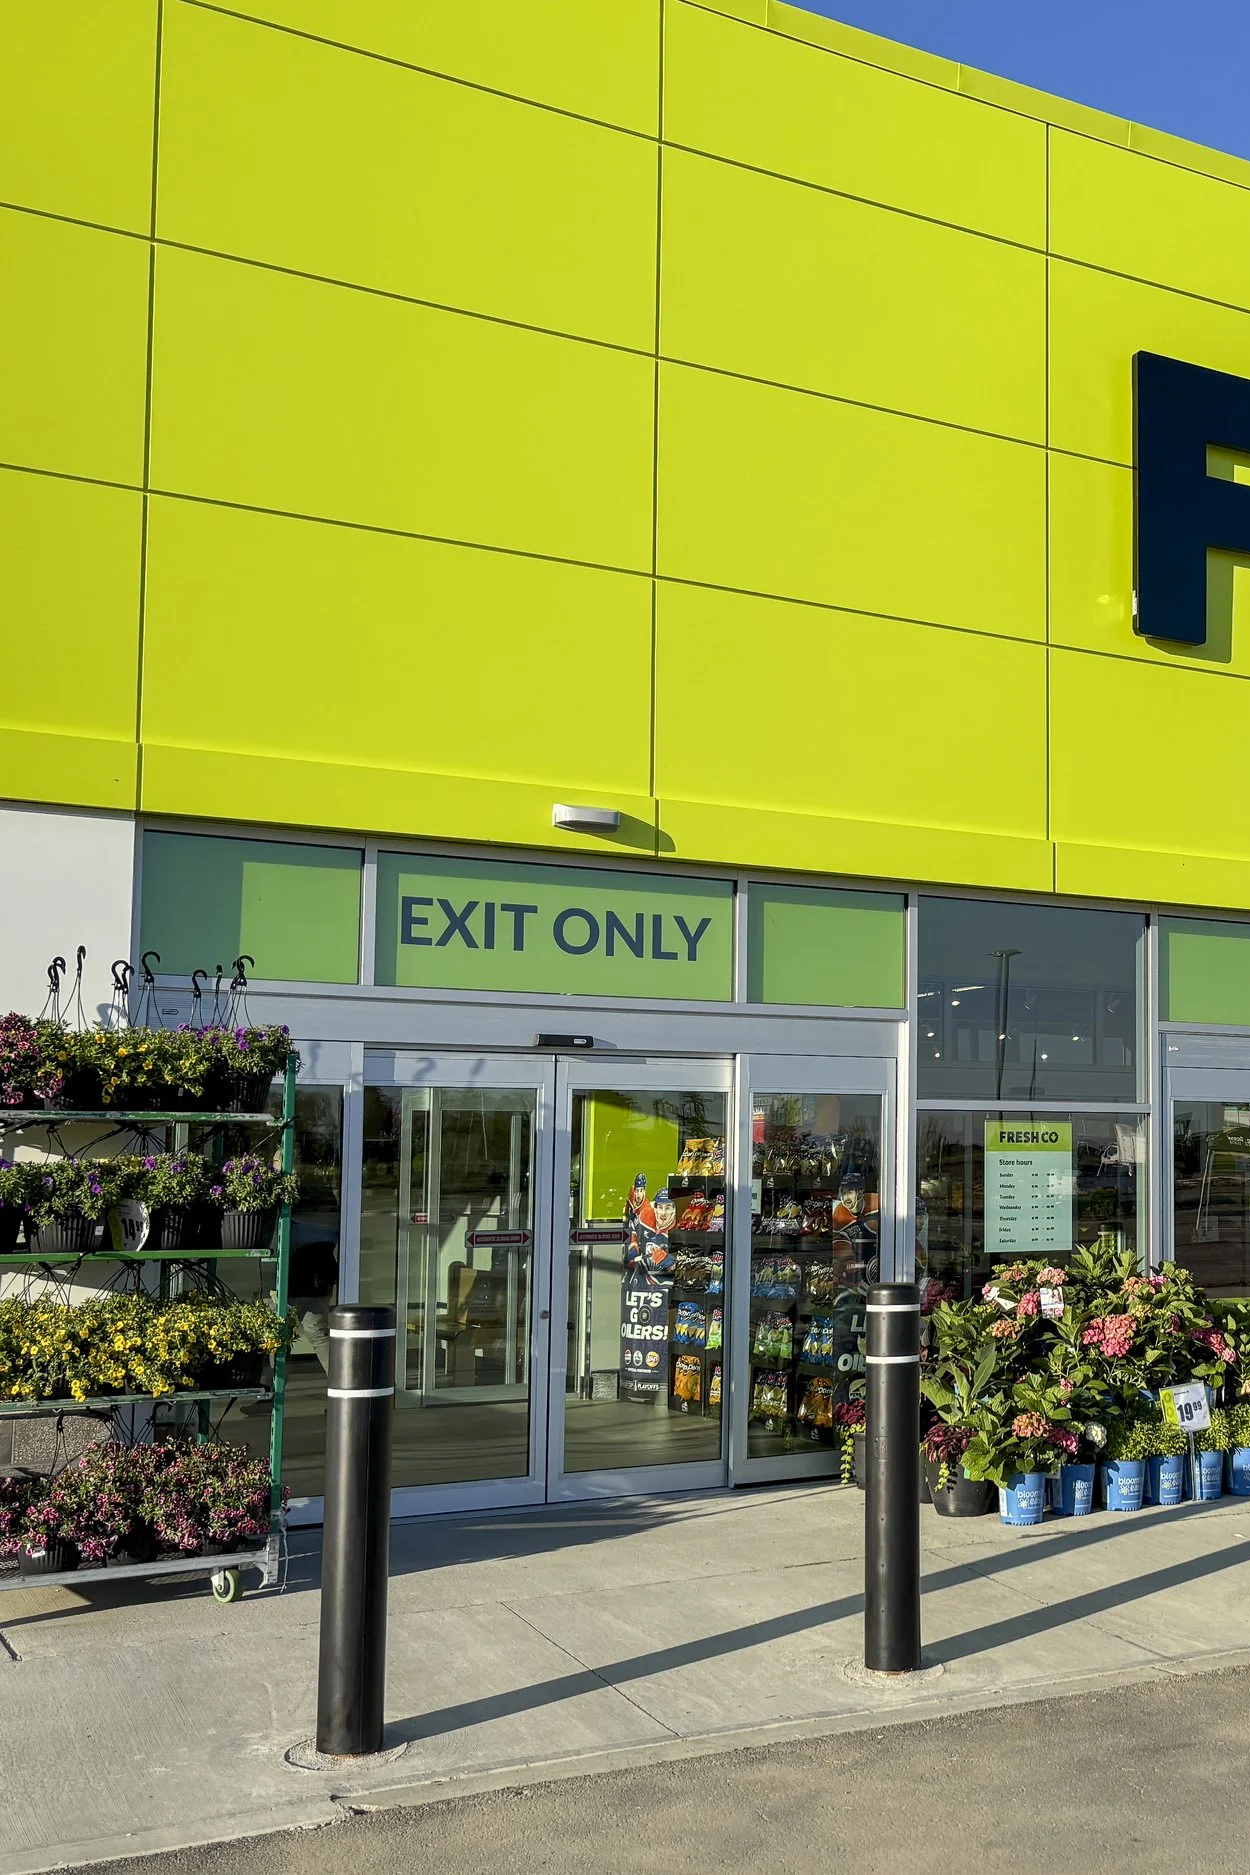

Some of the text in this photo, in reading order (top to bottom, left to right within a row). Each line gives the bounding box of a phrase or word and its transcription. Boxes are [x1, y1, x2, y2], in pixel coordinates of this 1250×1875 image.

[400, 895, 713, 962] EXIT ONLY
[625, 1291, 662, 1308] LET'S
[621, 1323, 668, 1340] OILERS!
